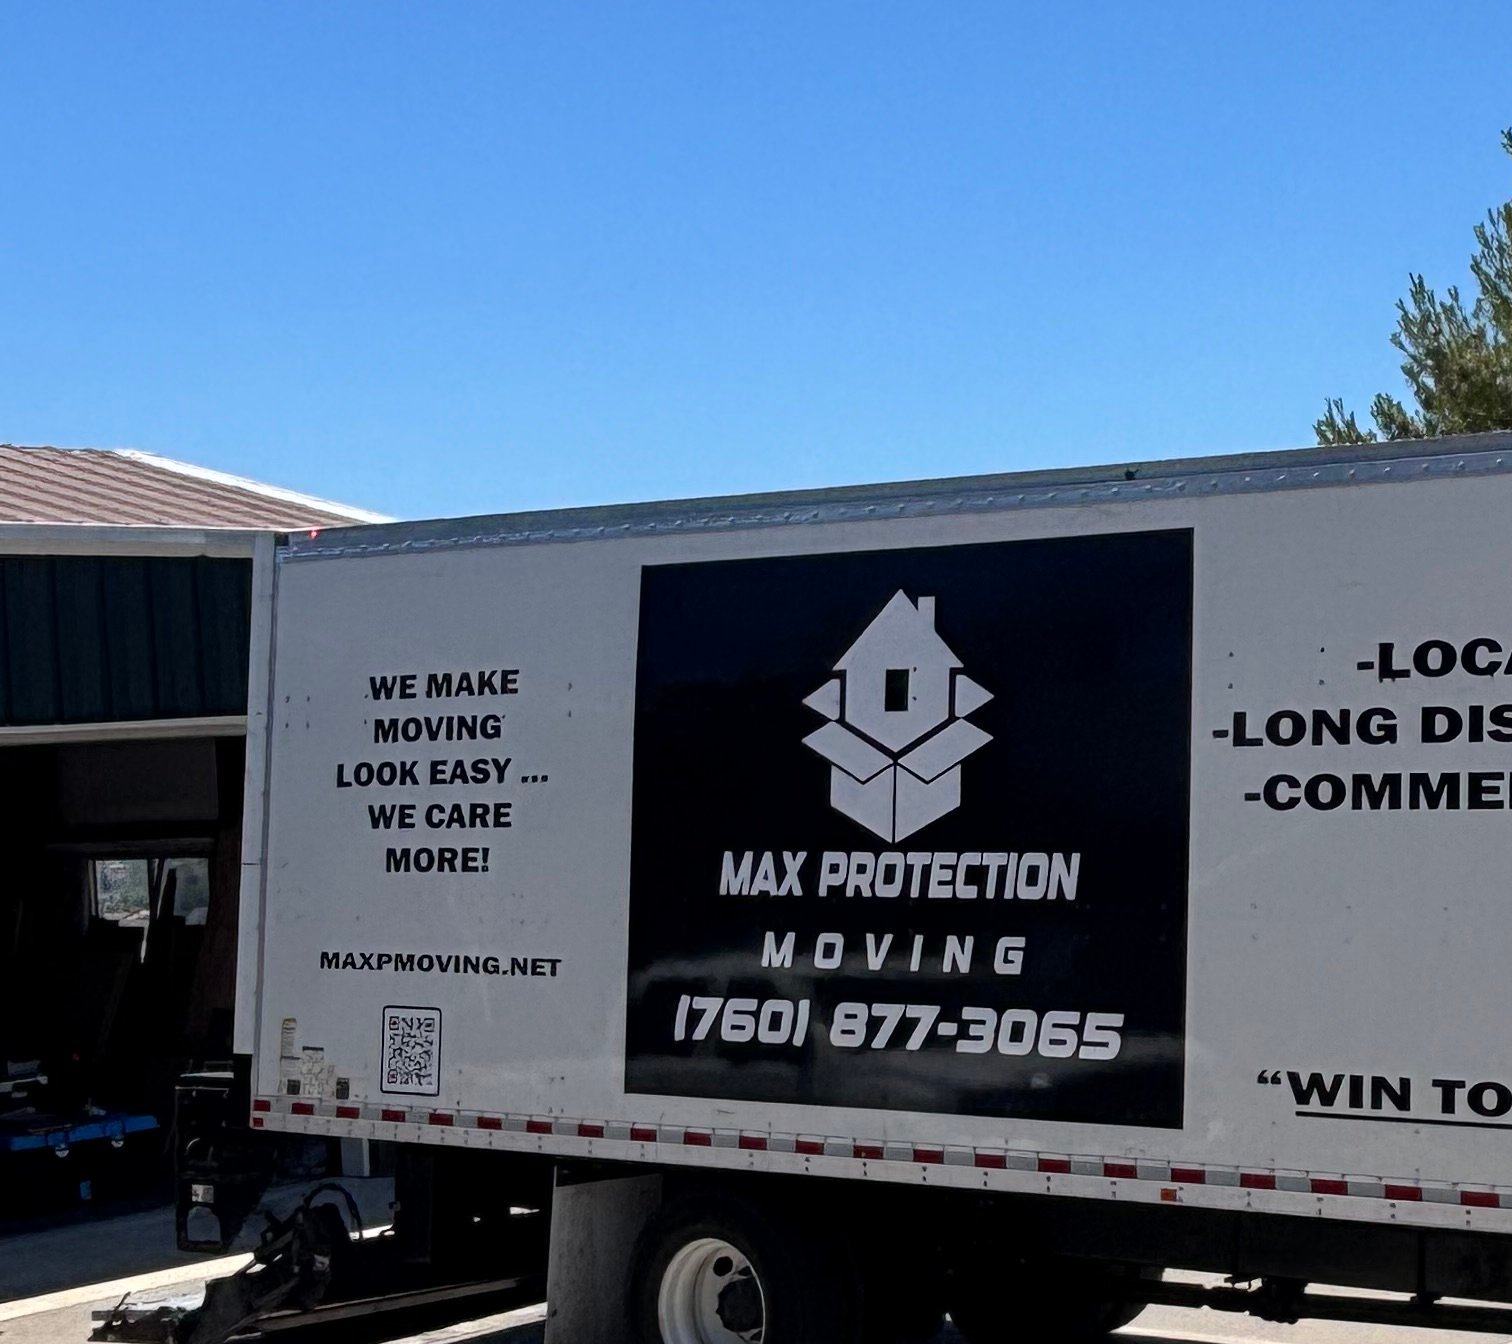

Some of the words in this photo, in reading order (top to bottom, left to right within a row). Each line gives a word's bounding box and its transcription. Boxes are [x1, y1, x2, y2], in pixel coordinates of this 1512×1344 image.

[369, 674, 418, 700] WE
[426, 669, 520, 699] MAKE
[373, 714, 502, 744] MOVING
[1212, 706, 1398, 748] -LONG
[336, 760, 420, 788] LOOK
[429, 758, 513, 786] EASY
[368, 804, 417, 830] WE
[425, 802, 513, 829] CARE
[385, 847, 490, 873] MORE!
[719, 851, 808, 897] MAX
[818, 851, 1081, 901] PROTECTION
[319, 951, 563, 978] MAXPMOVING.NET
[761, 931, 1027, 976] MOVING
[674, 994, 811, 1048] (760)
[829, 1001, 1126, 1061] 877-3065
